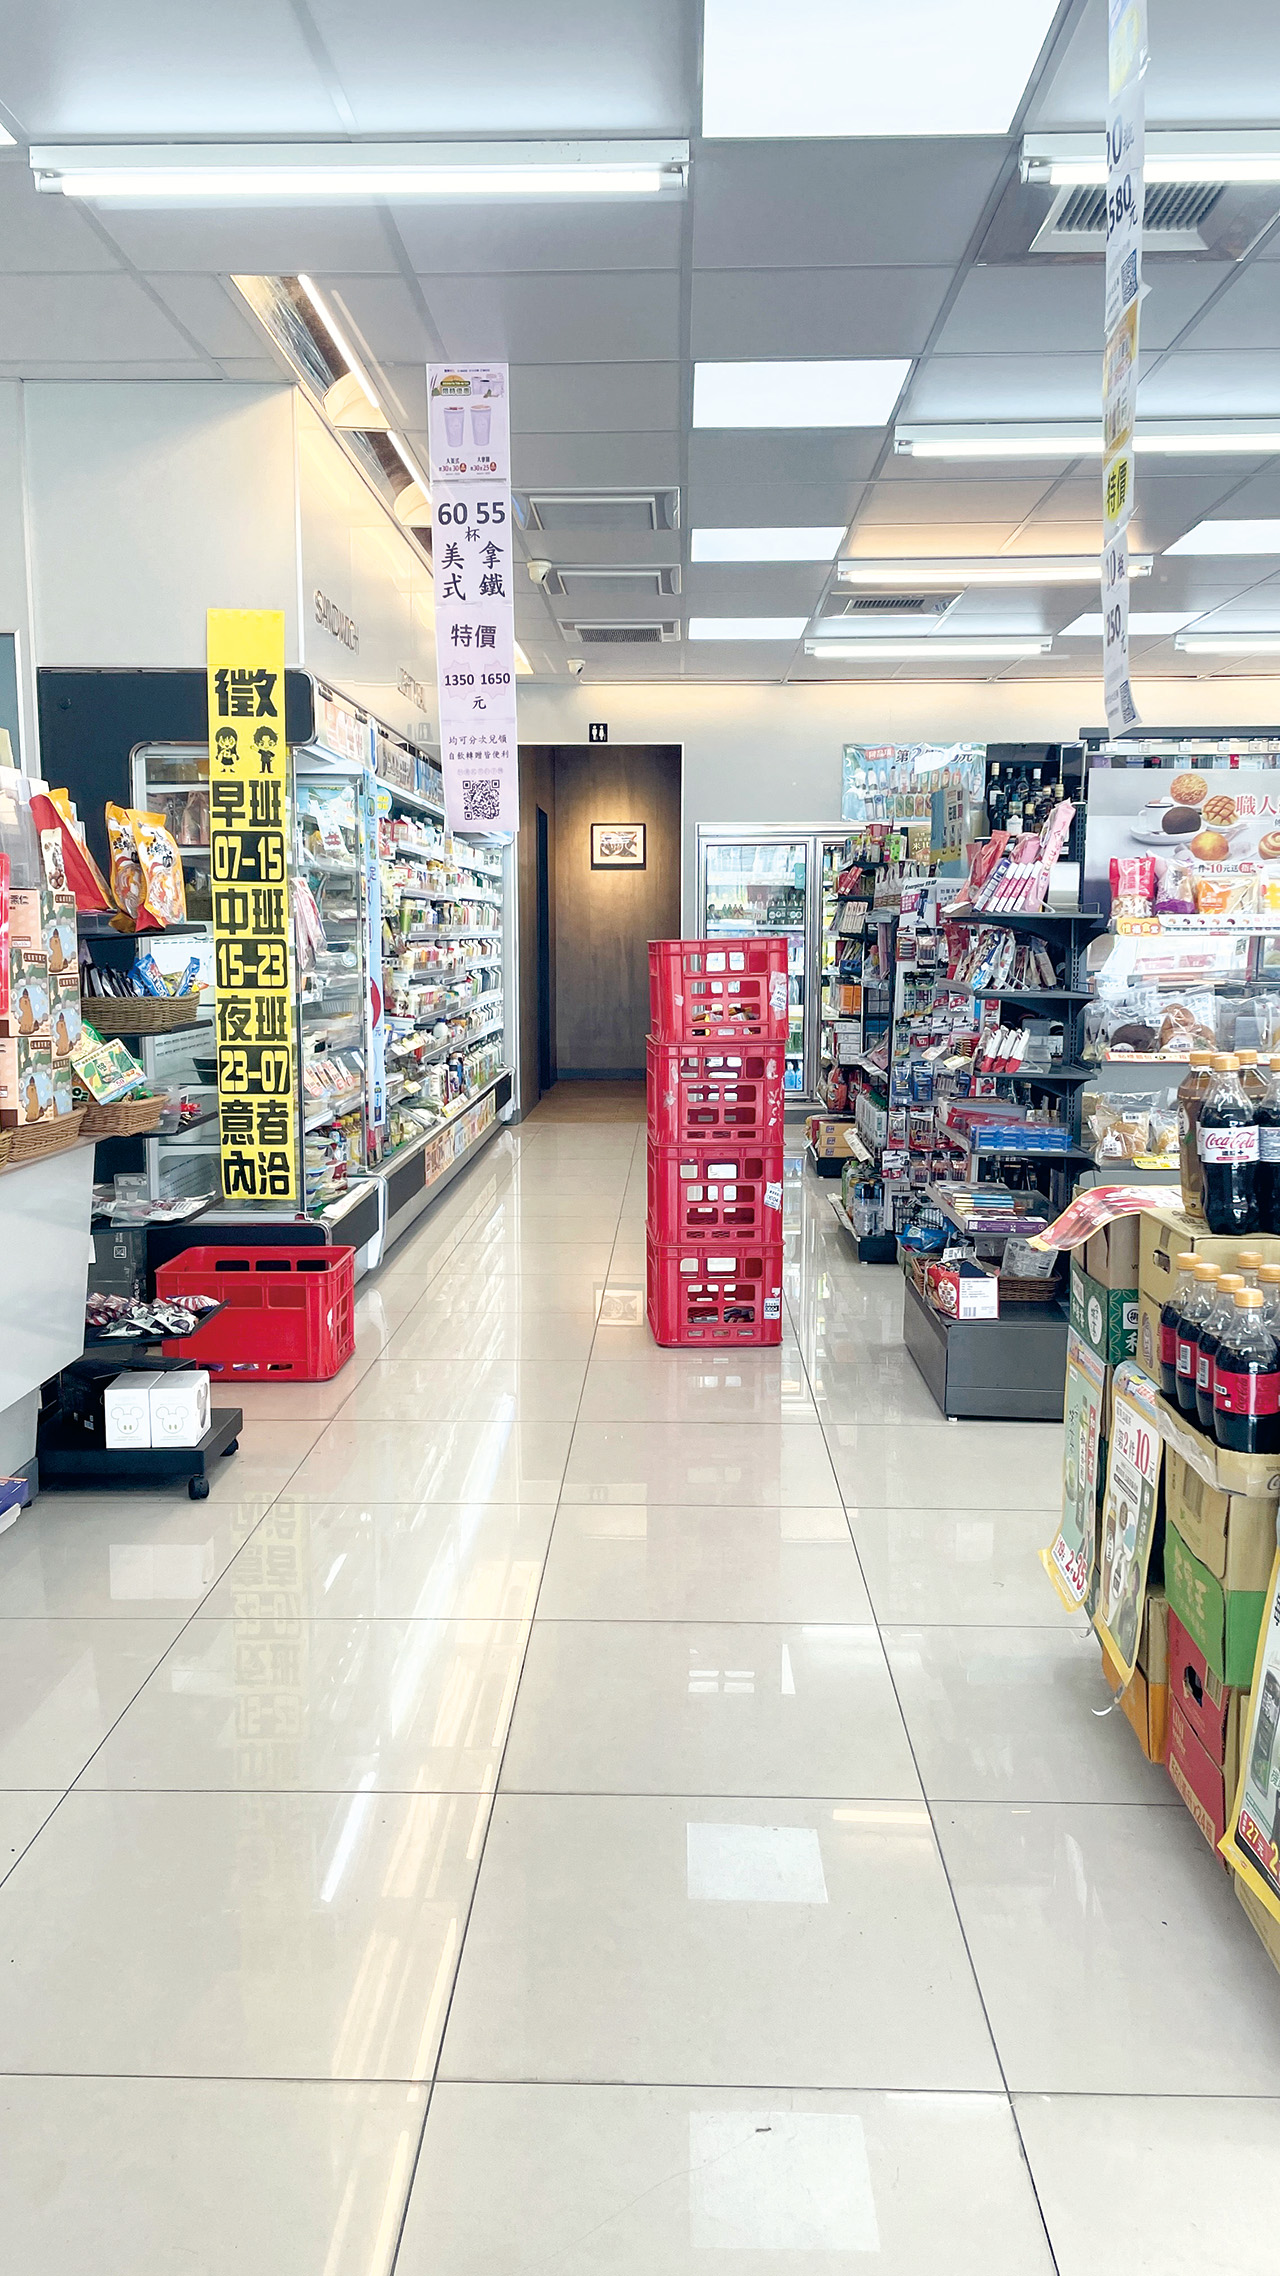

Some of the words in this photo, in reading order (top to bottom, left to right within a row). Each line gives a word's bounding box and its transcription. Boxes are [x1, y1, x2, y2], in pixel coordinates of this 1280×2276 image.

[438, 502, 467, 525] 60
[476, 502, 506, 524] 55
[464, 526, 481, 542] 杯
[441, 542, 466, 600] 美式
[479, 541, 506, 598] 拿鐵
[451, 624, 497, 649] 特價
[215, 668, 279, 717] 徵
[444, 674, 475, 686] 1350
[480, 672, 511, 685] 1650
[472, 696, 487, 710] 元
[211, 780, 283, 829] 早班
[1236, 795, 1280, 815] 職人
[214, 834, 282, 880] 07-15
[215, 889, 284, 936] 中班
[218, 939, 287, 987] 15-23
[218, 994, 288, 1045] 夜班
[221, 1047, 288, 1092] 23-07
[221, 1100, 289, 1145] 意者
[223, 1150, 290, 1196] 內洽
